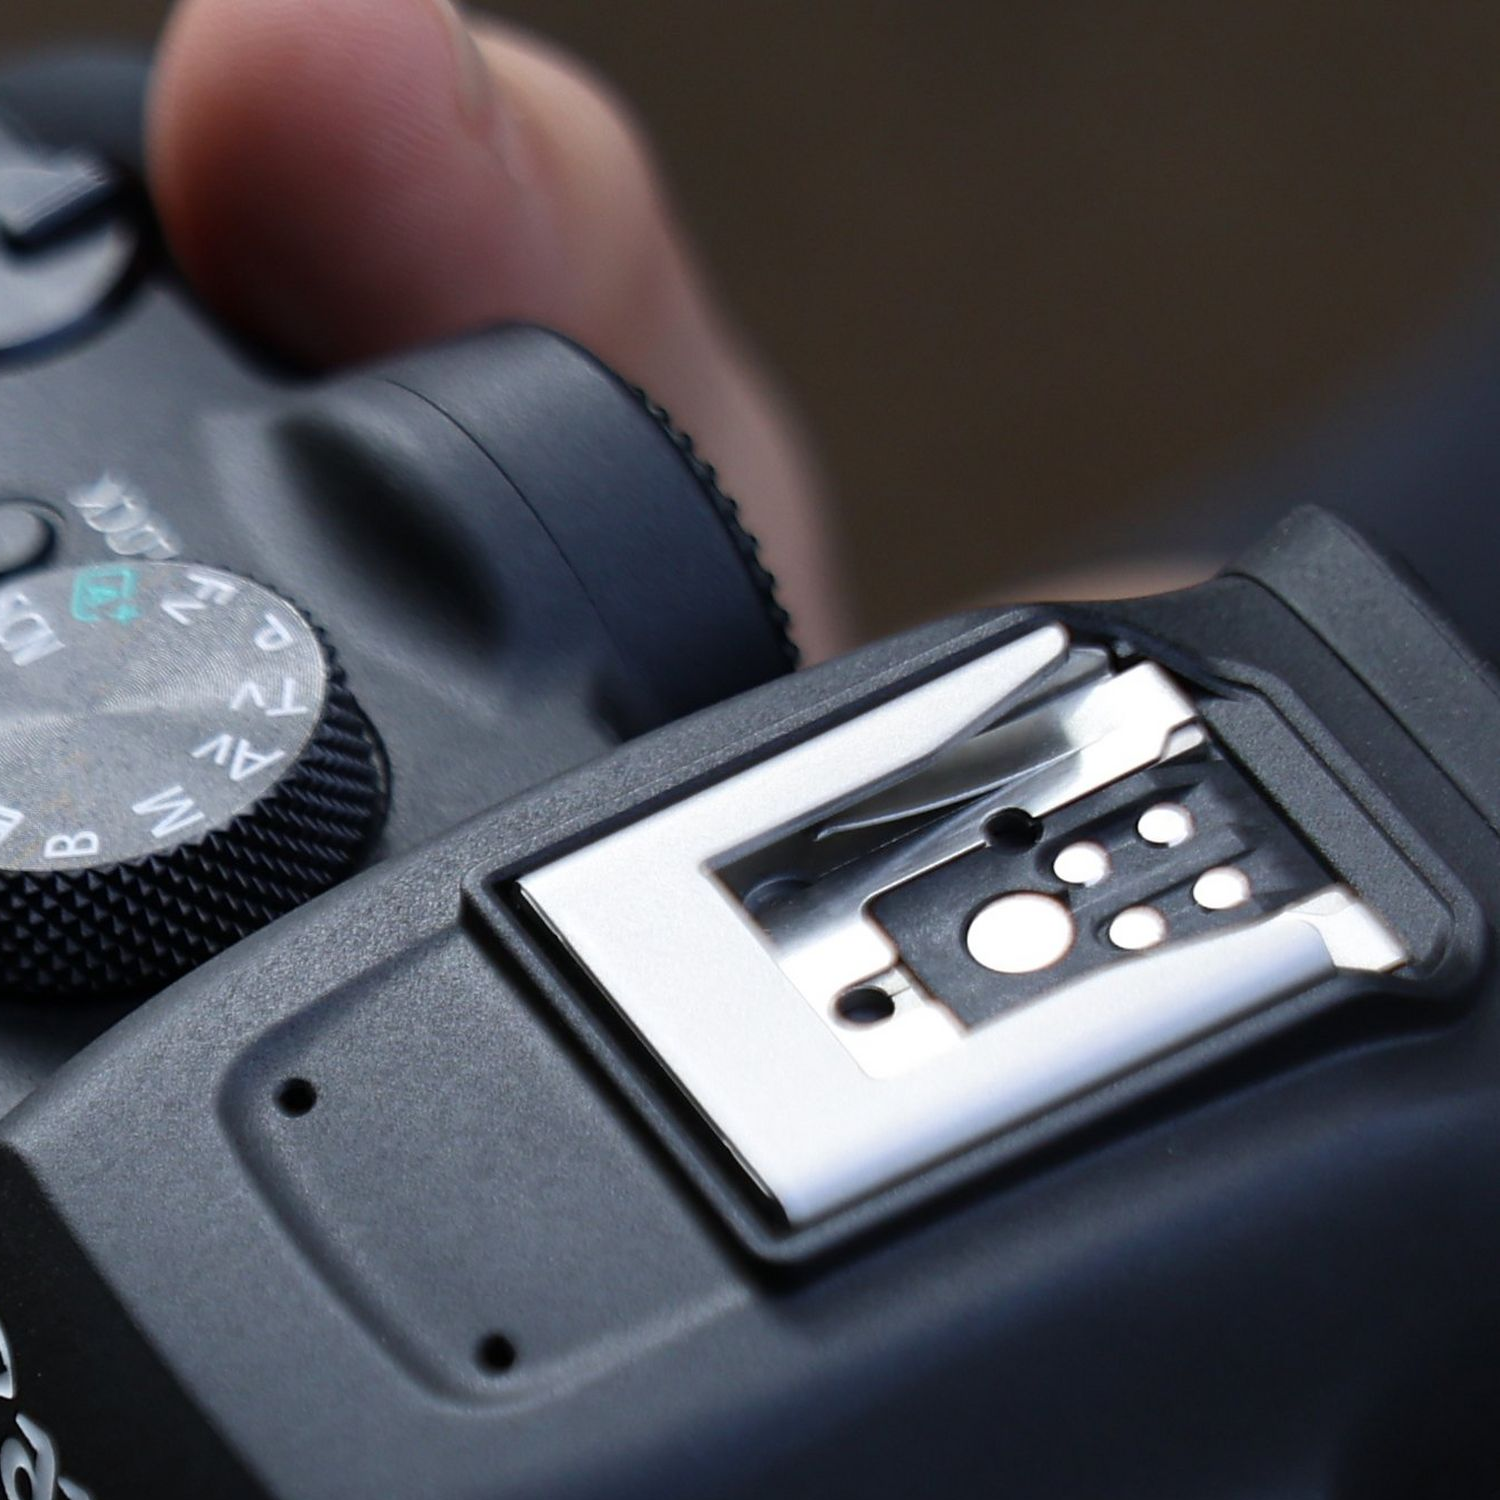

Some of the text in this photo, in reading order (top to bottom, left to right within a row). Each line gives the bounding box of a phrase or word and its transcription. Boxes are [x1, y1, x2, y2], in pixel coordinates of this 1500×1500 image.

[160, 567, 238, 625] Fv
[253, 613, 293, 651] P
[228, 677, 308, 717] Tv
[191, 733, 286, 781] Av
[132, 785, 204, 838] M
[43, 830, 100, 859] B
